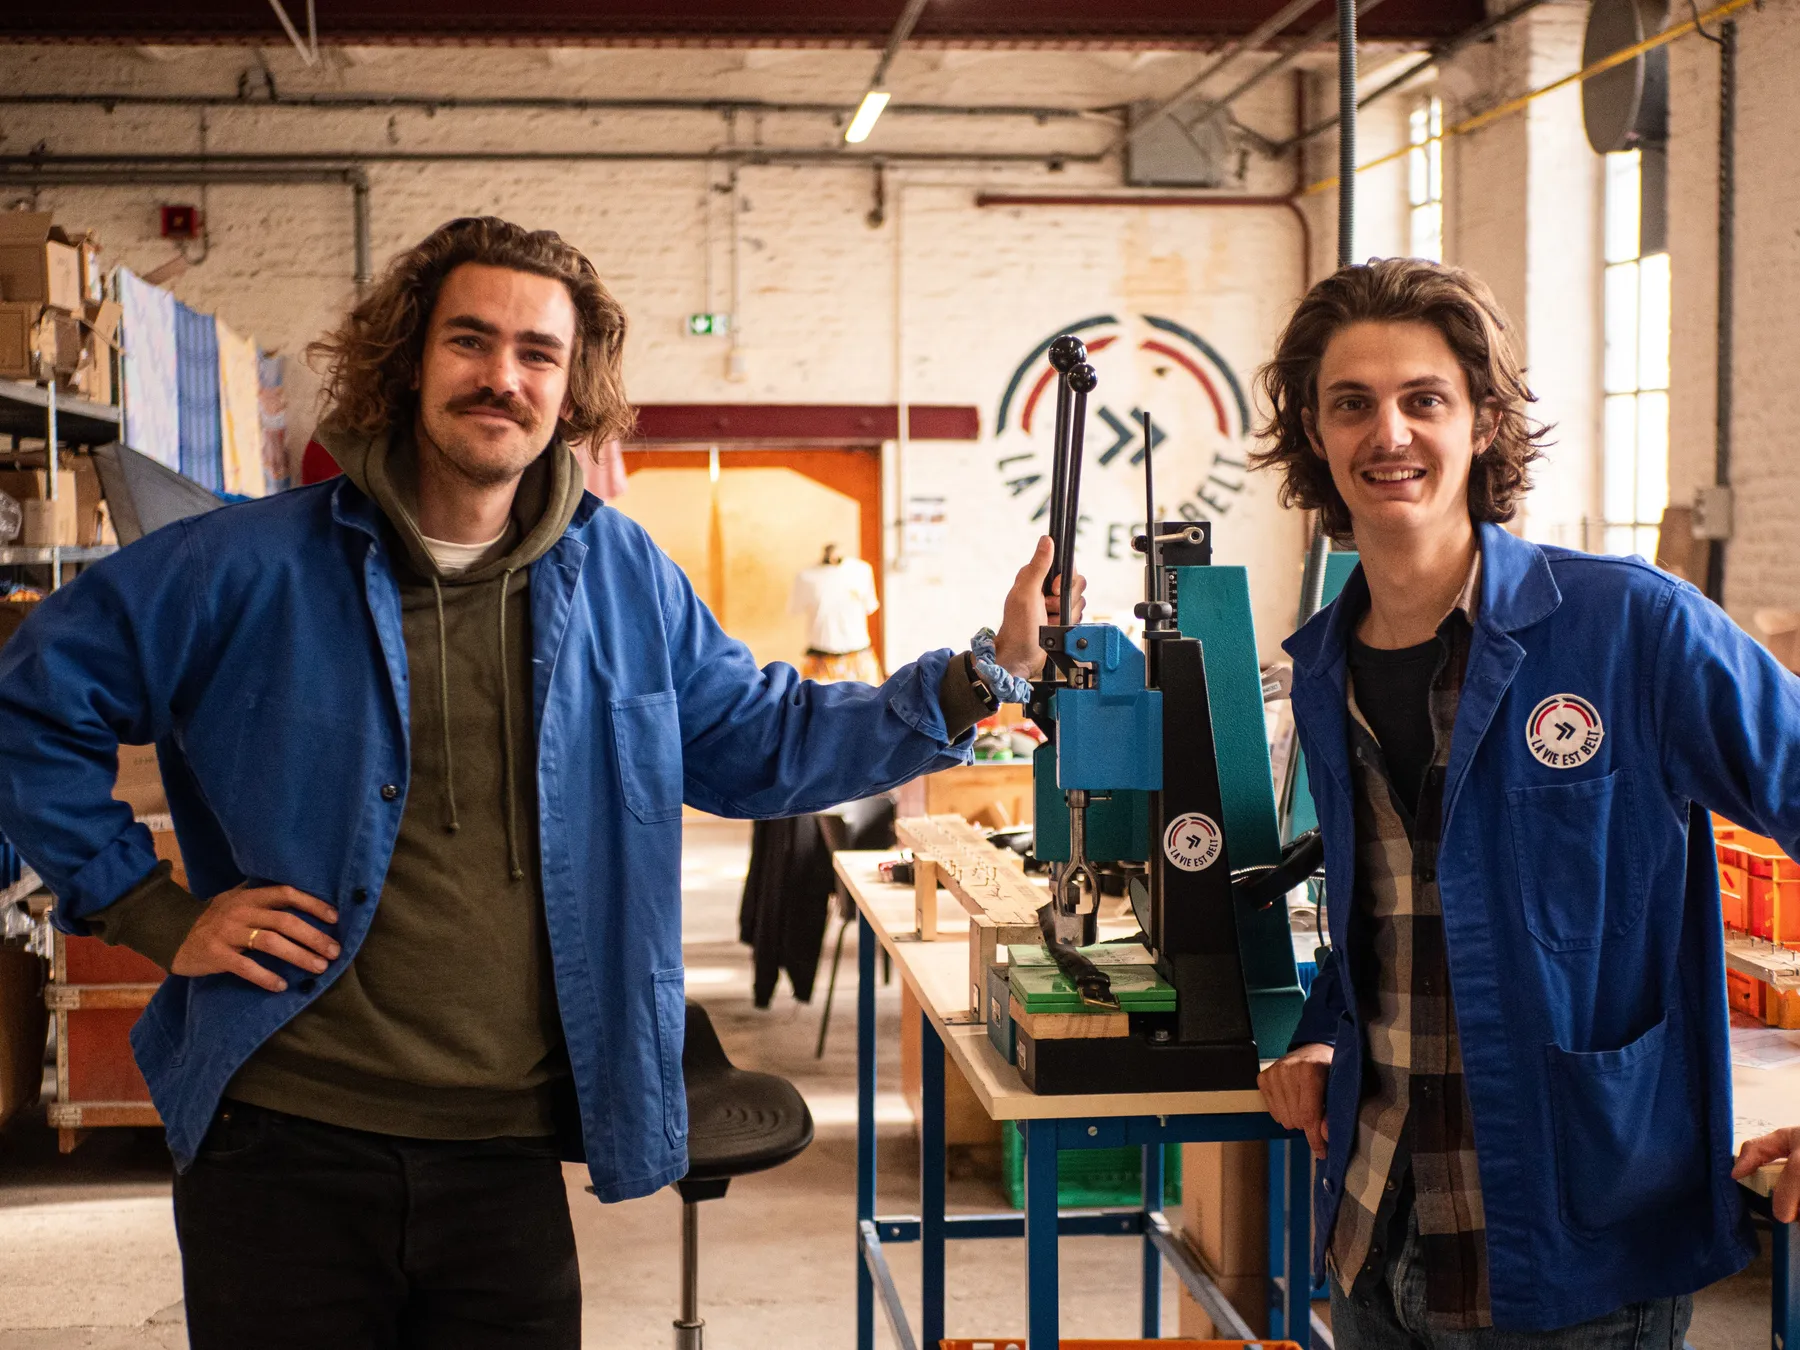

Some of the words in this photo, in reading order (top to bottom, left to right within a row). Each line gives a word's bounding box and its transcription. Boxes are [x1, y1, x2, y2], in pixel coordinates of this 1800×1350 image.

[998, 453, 1041, 497] LA
[1531, 739, 1546, 754] LA
[1542, 748, 1559, 765] VIE
[1562, 751, 1582, 766] EST
[1580, 730, 1600, 755] BELT
[1170, 848, 1180, 860] LA
[1180, 855, 1192, 867] VIE
[1193, 855, 1208, 867] EST
[1206, 839, 1218, 858] BELT
